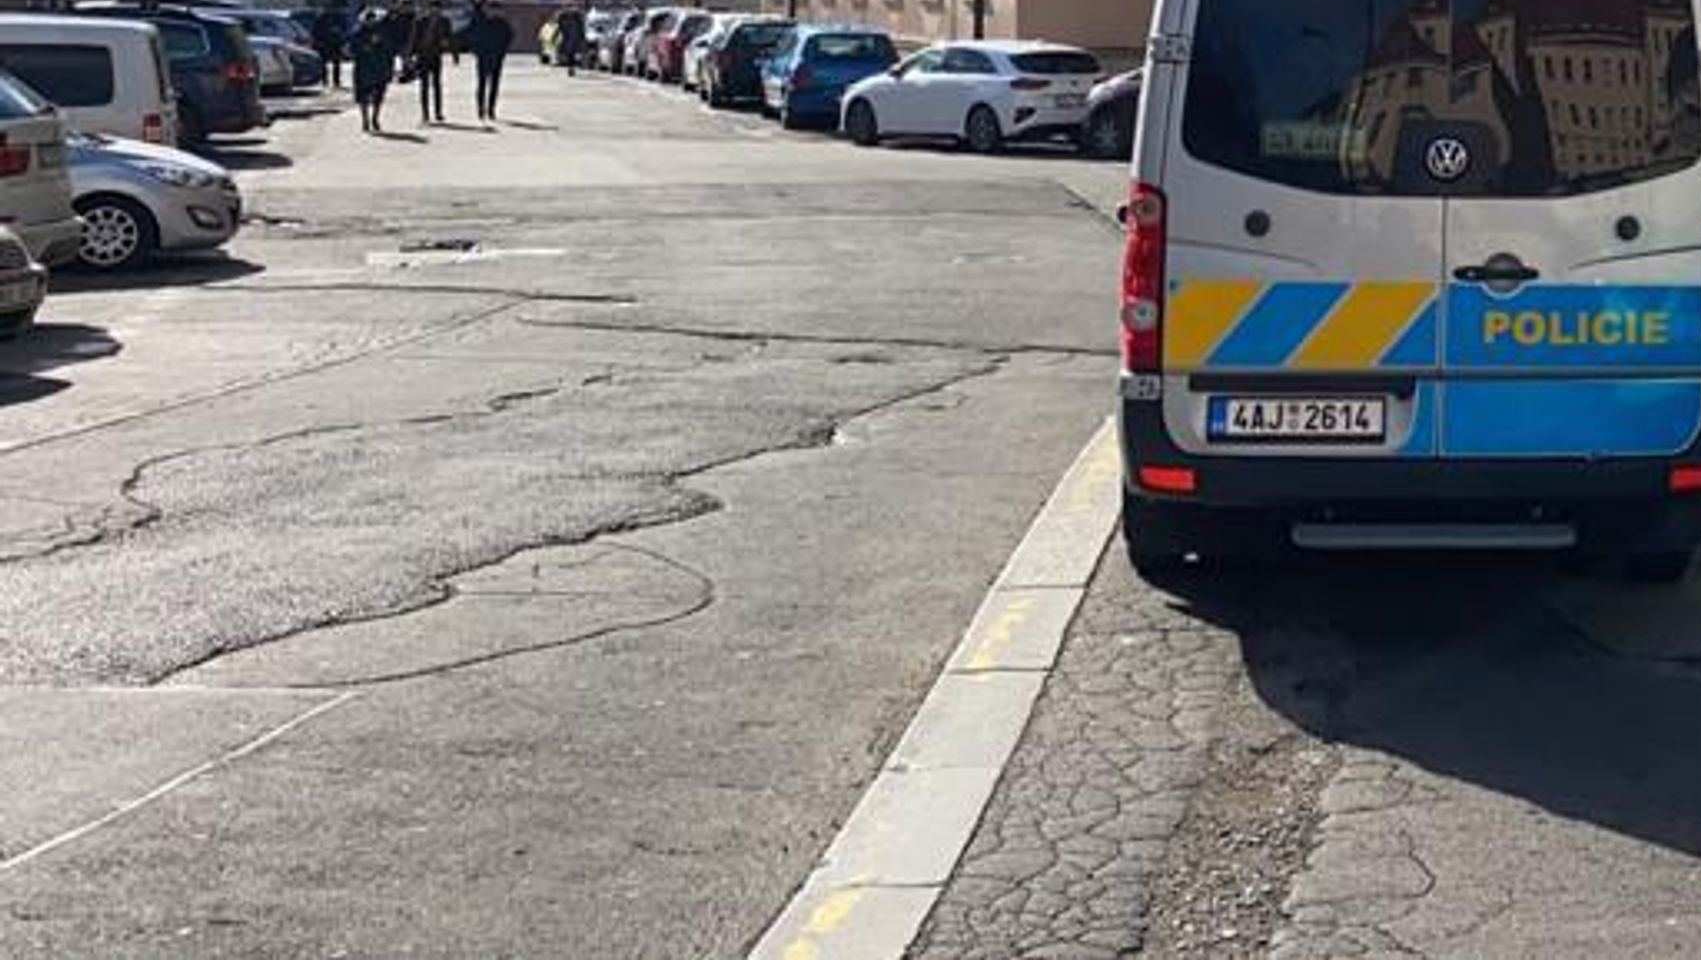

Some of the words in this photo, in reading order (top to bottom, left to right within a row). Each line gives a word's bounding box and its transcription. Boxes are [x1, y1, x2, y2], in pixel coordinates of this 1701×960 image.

[1484, 310, 1672, 345] POLICIE
[1233, 403, 1285, 431] 4AJ
[1304, 403, 1371, 431] 2614
